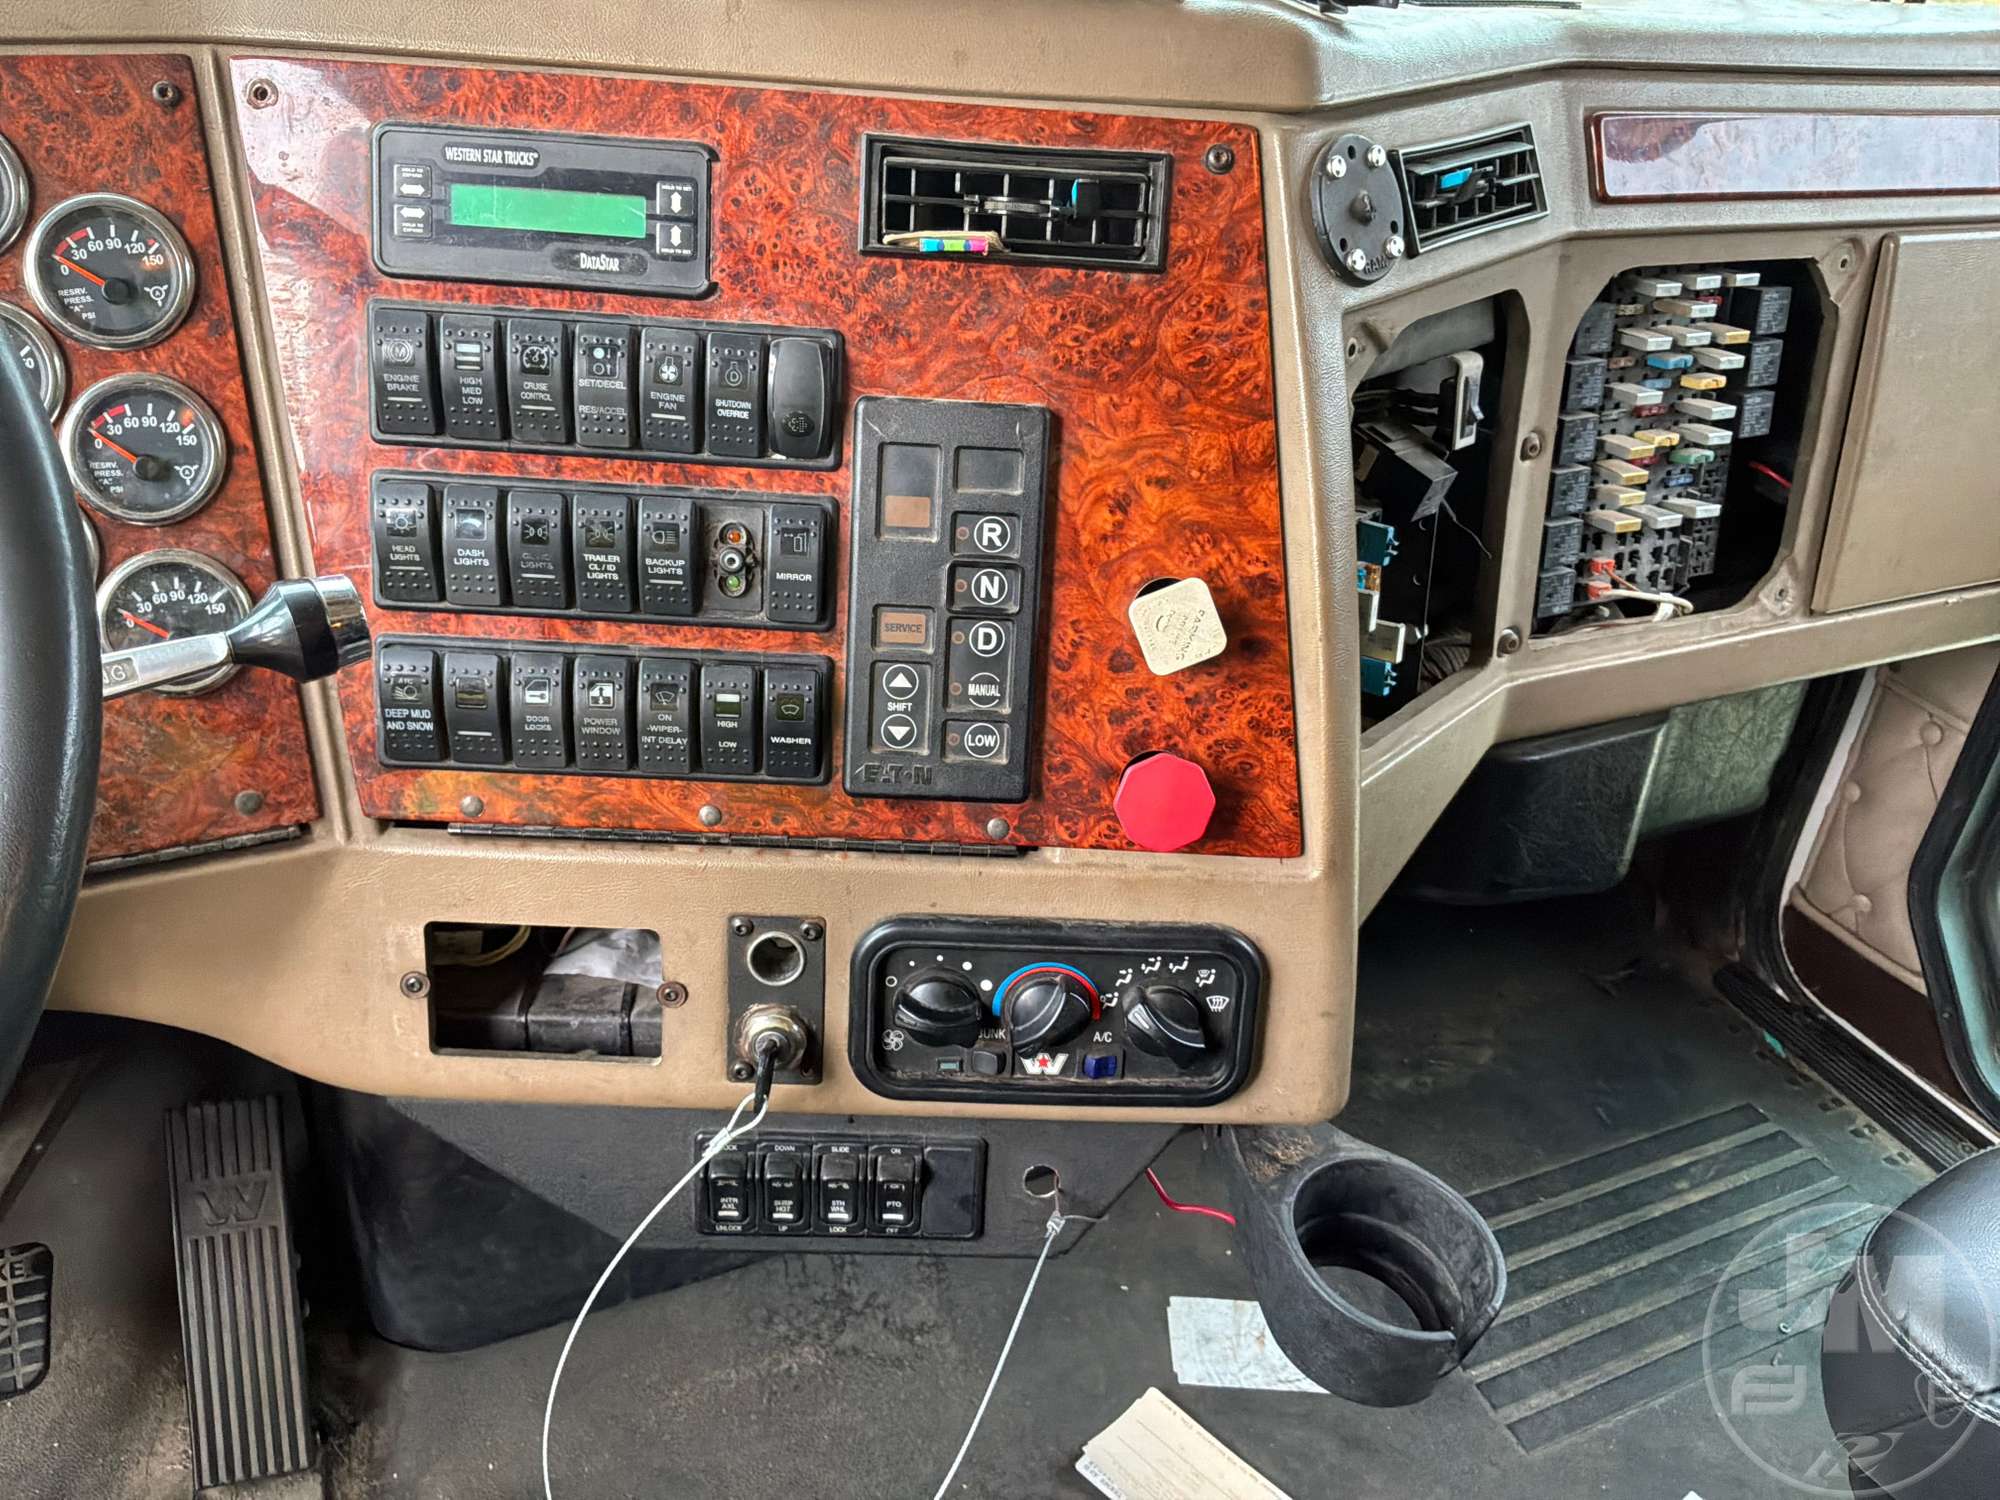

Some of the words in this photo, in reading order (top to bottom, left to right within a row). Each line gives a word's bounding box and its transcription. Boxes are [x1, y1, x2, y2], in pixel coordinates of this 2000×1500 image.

[445, 146, 482, 163] WESTERN
[484, 148, 503, 163] STAR
[87, 239, 104, 252] 60
[105, 237, 122, 250] 90
[124, 241, 145, 254] 120
[71, 249, 87, 260] 30
[142, 254, 164, 266] 150
[61, 264, 69, 276] 0
[58, 288, 88, 296] RESRV.
[384, 374, 420, 383] ENGINE
[460, 377, 483, 386] HIGH
[387, 383, 419, 392] BRAKE
[523, 382, 548, 391] CRUISE
[578, 379, 627, 390] SET/DECEL
[462, 387, 482, 395] MED
[521, 391, 552, 401] CONTROL
[462, 396, 483, 405] LOW
[650, 392, 685, 402] ENGINE
[658, 401, 677, 410] FAN
[715, 399, 752, 409] SHUTDOWN
[578, 405, 627, 416] RES/ACCEL
[717, 409, 750, 420] OVERRIDE
[124, 417, 139, 428] 60
[142, 416, 157, 427] 90
[107, 424, 122, 436] 30
[159, 421, 180, 433] 120
[95, 438, 103, 449] 0
[176, 435, 197, 446] 150
[982, 523, 1002, 547] R
[392, 545, 416, 553] HEAD
[458, 549, 485, 557] DASH
[390, 553, 420, 561] LIGHTS
[583, 553, 620, 563] TRAILER
[454, 558, 490, 567] LIGHTS
[588, 563, 600, 571] CL
[606, 564, 616, 572] ID
[645, 558, 685, 567] BACKUP
[587, 572, 619, 581] LIGHTS
[648, 567, 683, 576] LIGHTS
[776, 572, 812, 582] MIRROR
[980, 575, 999, 599] N
[152, 593, 167, 605] 60
[169, 590, 185, 601] 90
[187, 591, 208, 604] 120
[136, 602, 152, 613] 30
[205, 602, 226, 615] 150
[127, 618, 134, 628] 0
[884, 623, 922, 633] SERVICE
[978, 627, 997, 650] D
[968, 683, 1001, 697] MANUAL
[887, 701, 912, 712] SHIFT
[384, 708, 409, 718] DEEP
[410, 710, 431, 719] MUD
[658, 714, 672, 722] ON
[387, 721, 405, 730] AND
[406, 722, 433, 731] SNOW
[583, 717, 618, 726] POWER
[717, 720, 738, 729] HIGH
[582, 727, 621, 735] WINDOW
[641, 736, 657, 744] INT
[658, 737, 688, 746] DELAY
[718, 740, 737, 748] LOW
[771, 736, 812, 745] WASHER
[968, 734, 997, 747] LOW
[860, 763, 933, 785] EATON
[1093, 1031, 1112, 1043] A/C
